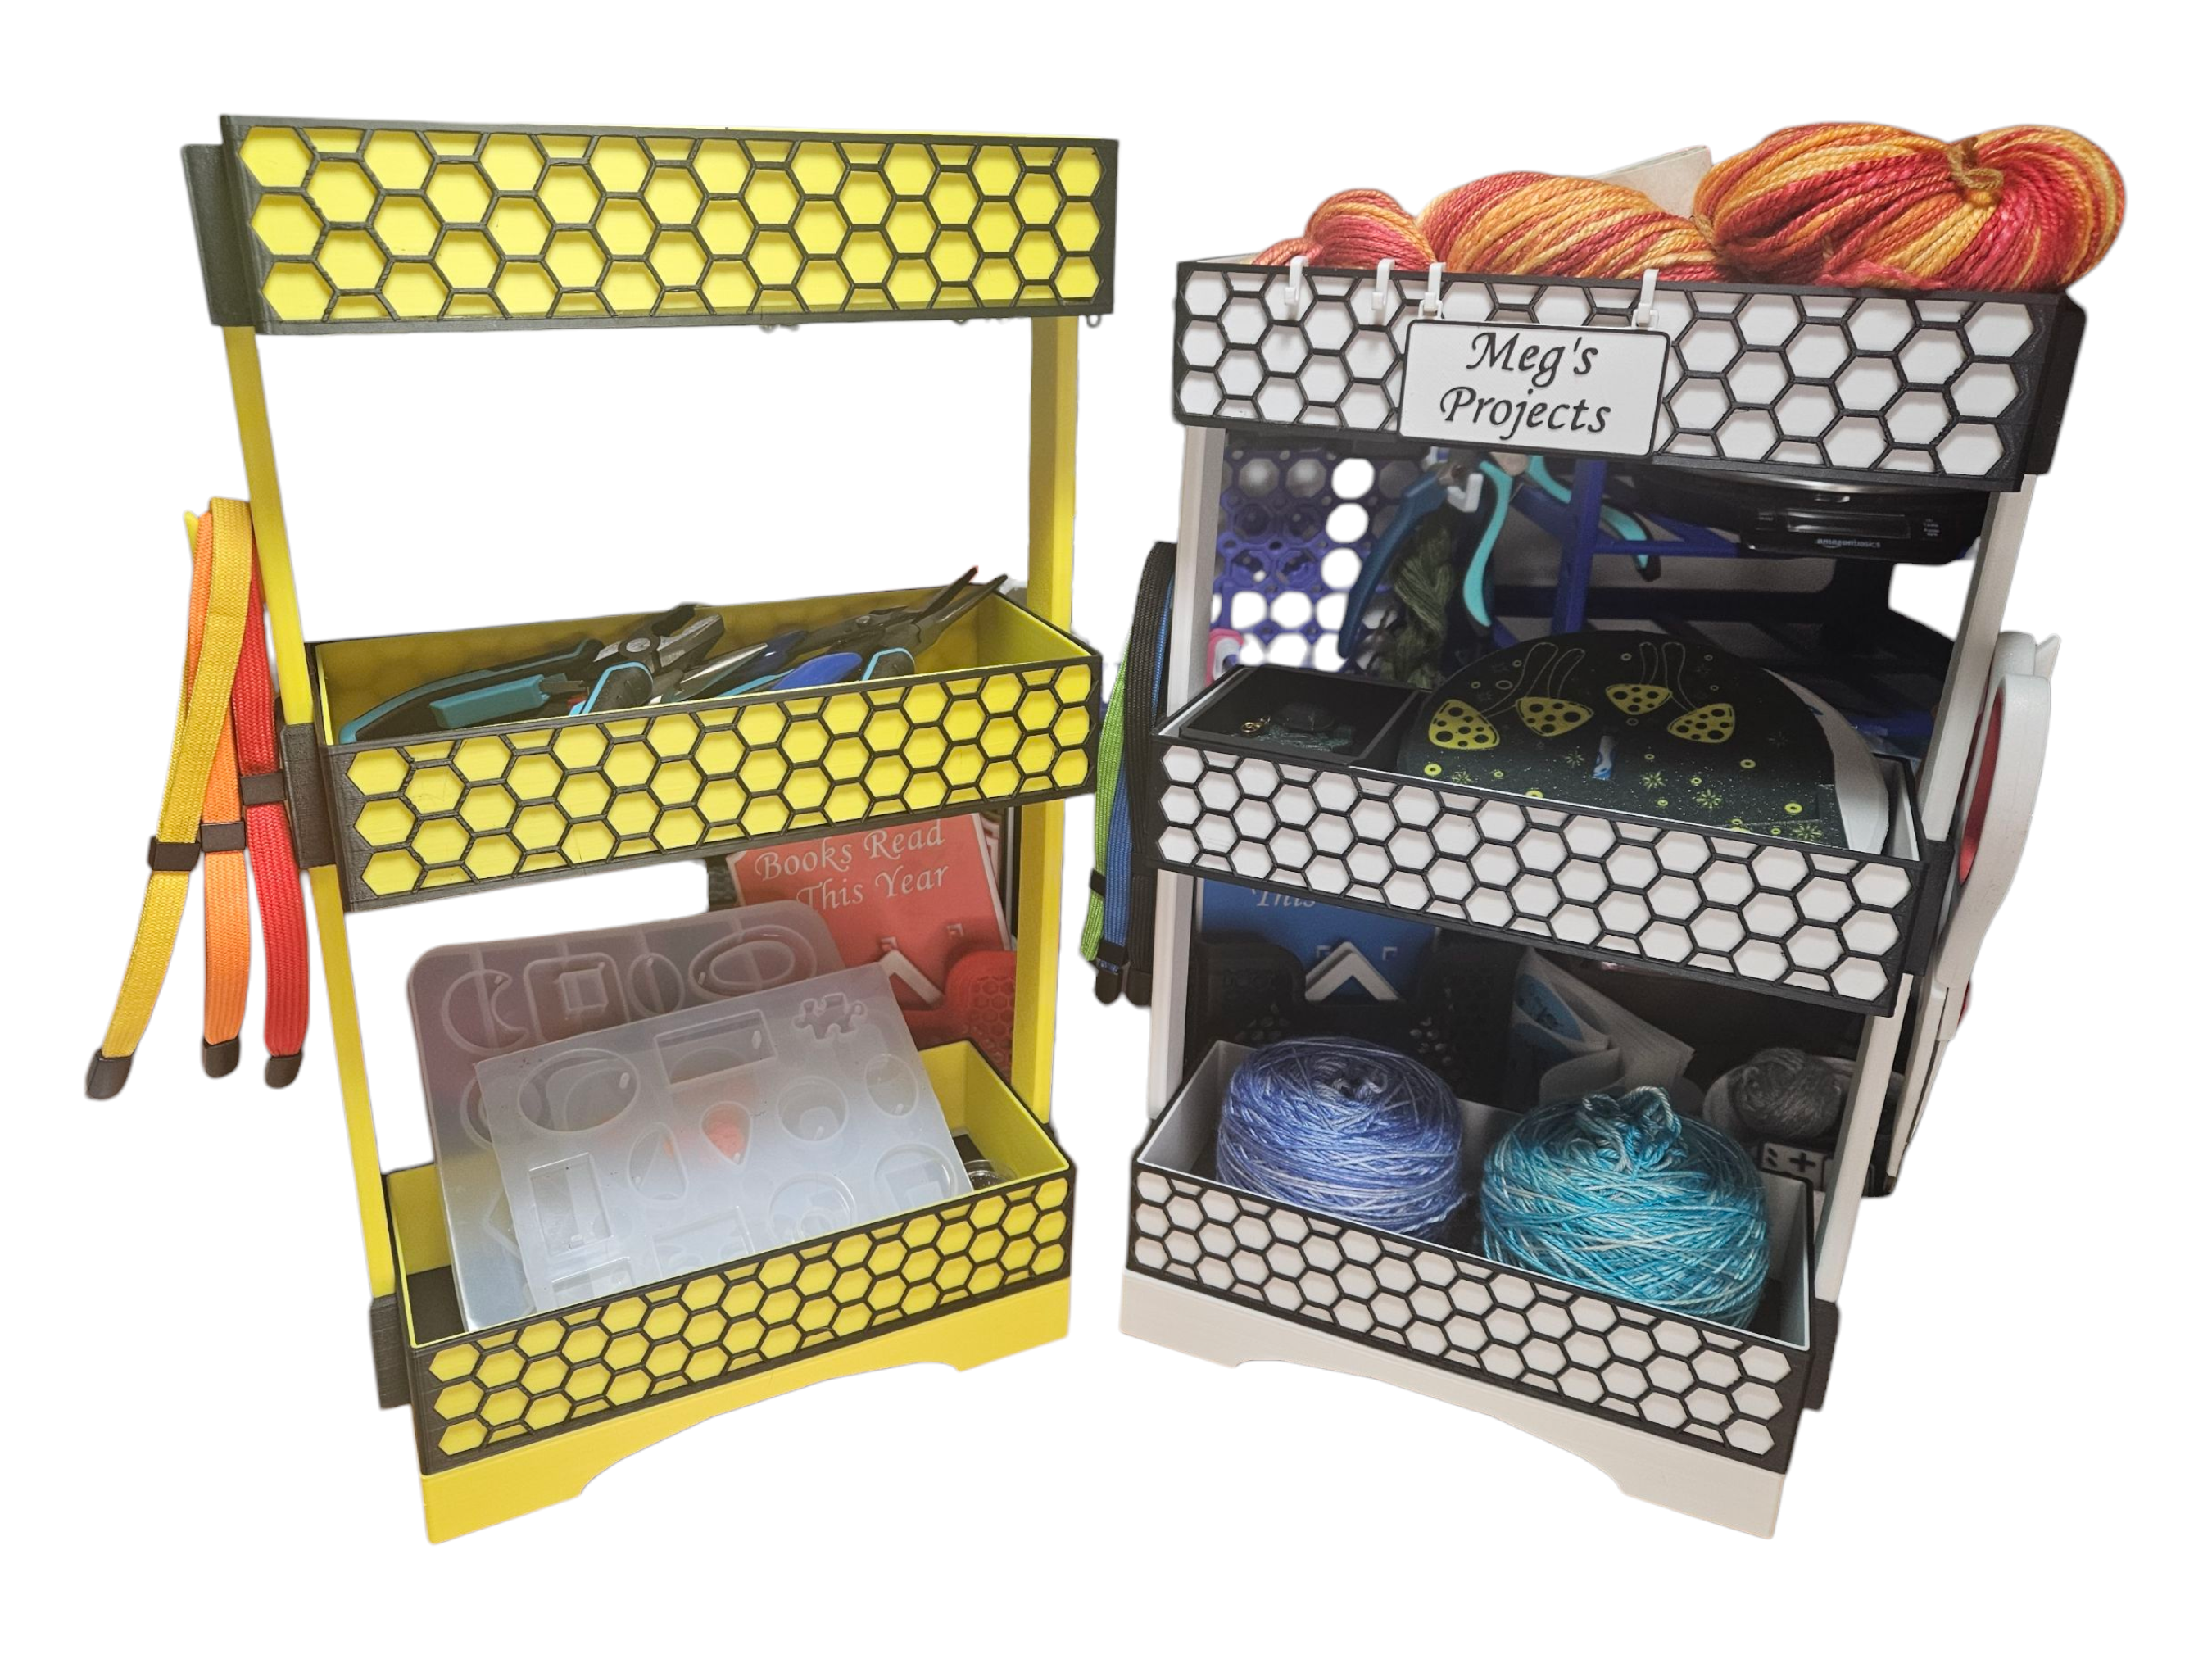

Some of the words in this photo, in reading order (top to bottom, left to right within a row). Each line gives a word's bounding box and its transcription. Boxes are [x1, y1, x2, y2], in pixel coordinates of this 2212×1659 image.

[1466, 332, 1598, 388] Meg's
[1440, 386, 1611, 440] Projects
[754, 837, 853, 882] Books
[863, 819, 945, 860] Read
[796, 877, 864, 913] This
[874, 865, 950, 899] Year
